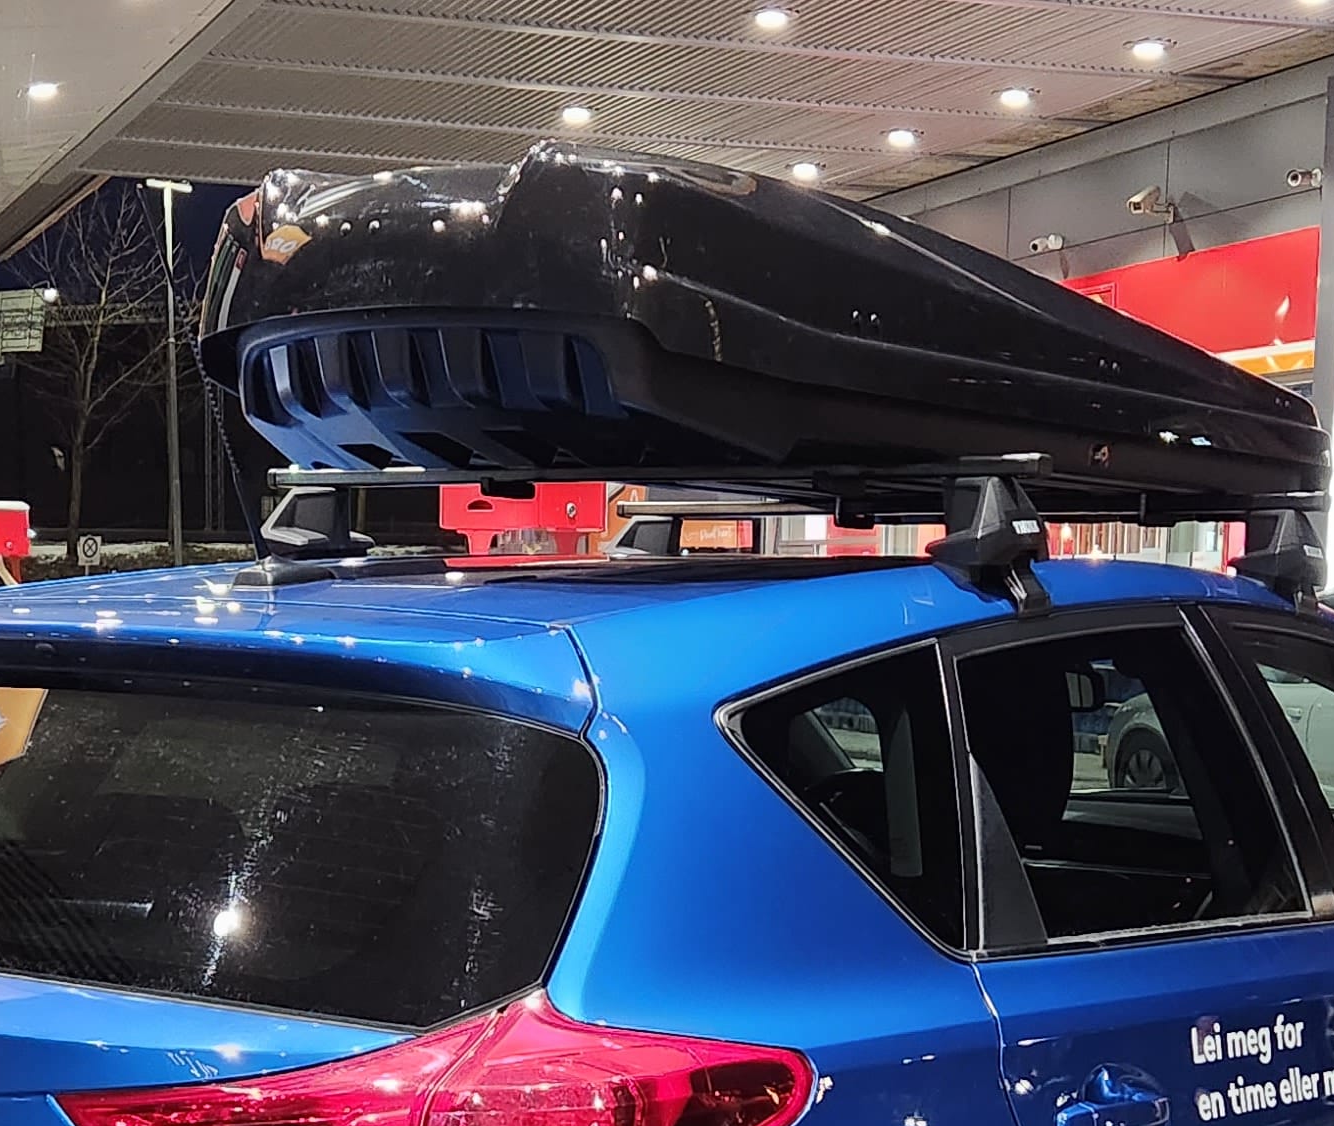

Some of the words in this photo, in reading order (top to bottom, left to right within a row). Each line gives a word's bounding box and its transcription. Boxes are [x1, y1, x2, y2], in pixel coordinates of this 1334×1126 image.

[1191, 1022, 1223, 1064] Lei
[1226, 1025, 1272, 1064] meg
[1274, 1014, 1305, 1051] for
[1197, 1090, 1227, 1122] en
[1227, 1075, 1277, 1115] time
[1279, 1066, 1320, 1105] eller
